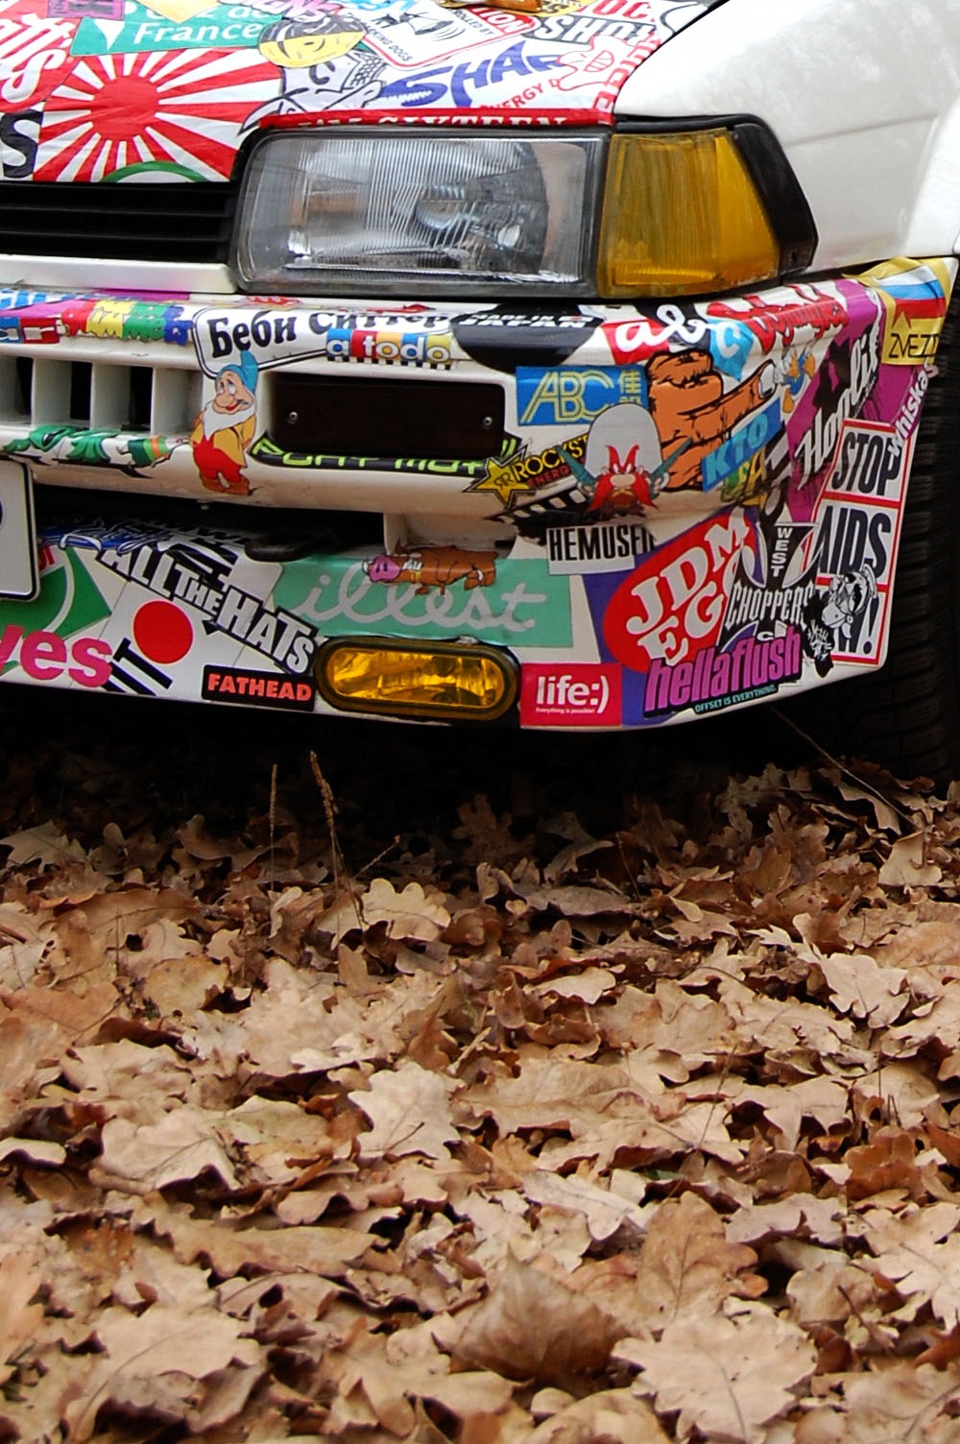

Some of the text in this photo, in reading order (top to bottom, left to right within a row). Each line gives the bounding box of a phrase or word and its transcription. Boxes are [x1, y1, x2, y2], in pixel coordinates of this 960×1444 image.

[133, 22, 263, 44] France
[206, 310, 297, 358] Беби
[458, 319, 587, 329] JAPAN
[519, 369, 616, 424] ABC
[831, 431, 902, 496] STOP
[770, 526, 793, 577] WEST
[818, 505, 892, 579] AIDS
[293, 559, 547, 632] illest
[626, 505, 751, 636] JDM
[173, 562, 224, 615] THE
[214, 588, 315, 674] HATS
[207, 672, 313, 702] FATHEAD
[644, 625, 801, 712] hellaflush
[694, 699, 723, 713] OFFSET
